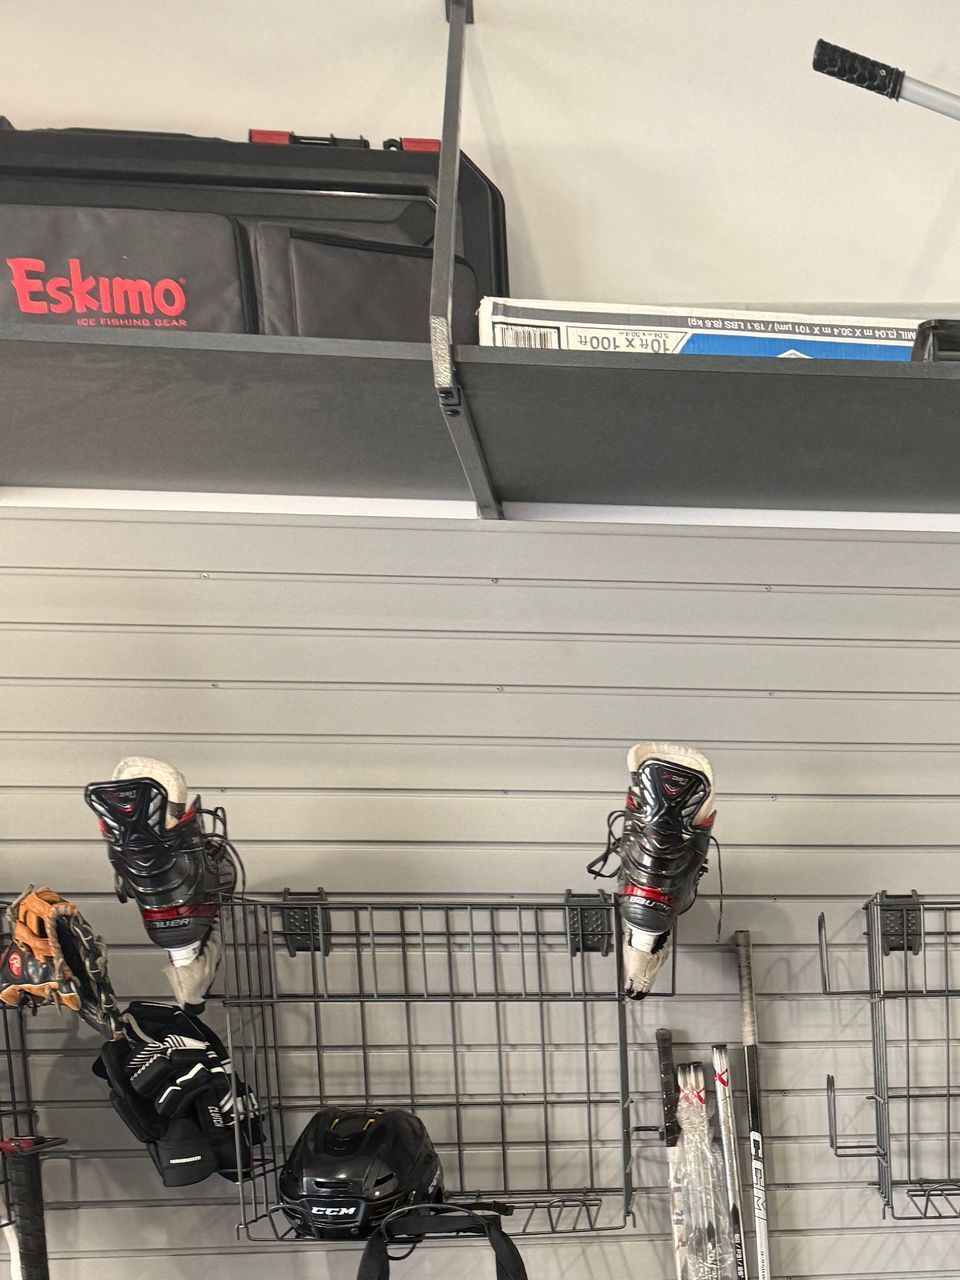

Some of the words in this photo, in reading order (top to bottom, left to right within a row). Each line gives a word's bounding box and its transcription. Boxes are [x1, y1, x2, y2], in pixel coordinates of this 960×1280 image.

[77, 318, 96, 326] ICE
[100, 318, 150, 327] FISHING
[155, 319, 187, 327] GEAR
[724, 320, 745, 330] LBS
[794, 324, 811, 334] 101
[833, 326, 853, 337] 30.4
[874, 328, 897, 338] (3.04
[750, 1131, 767, 1219] CCM
[311, 1206, 357, 1216] CCM
